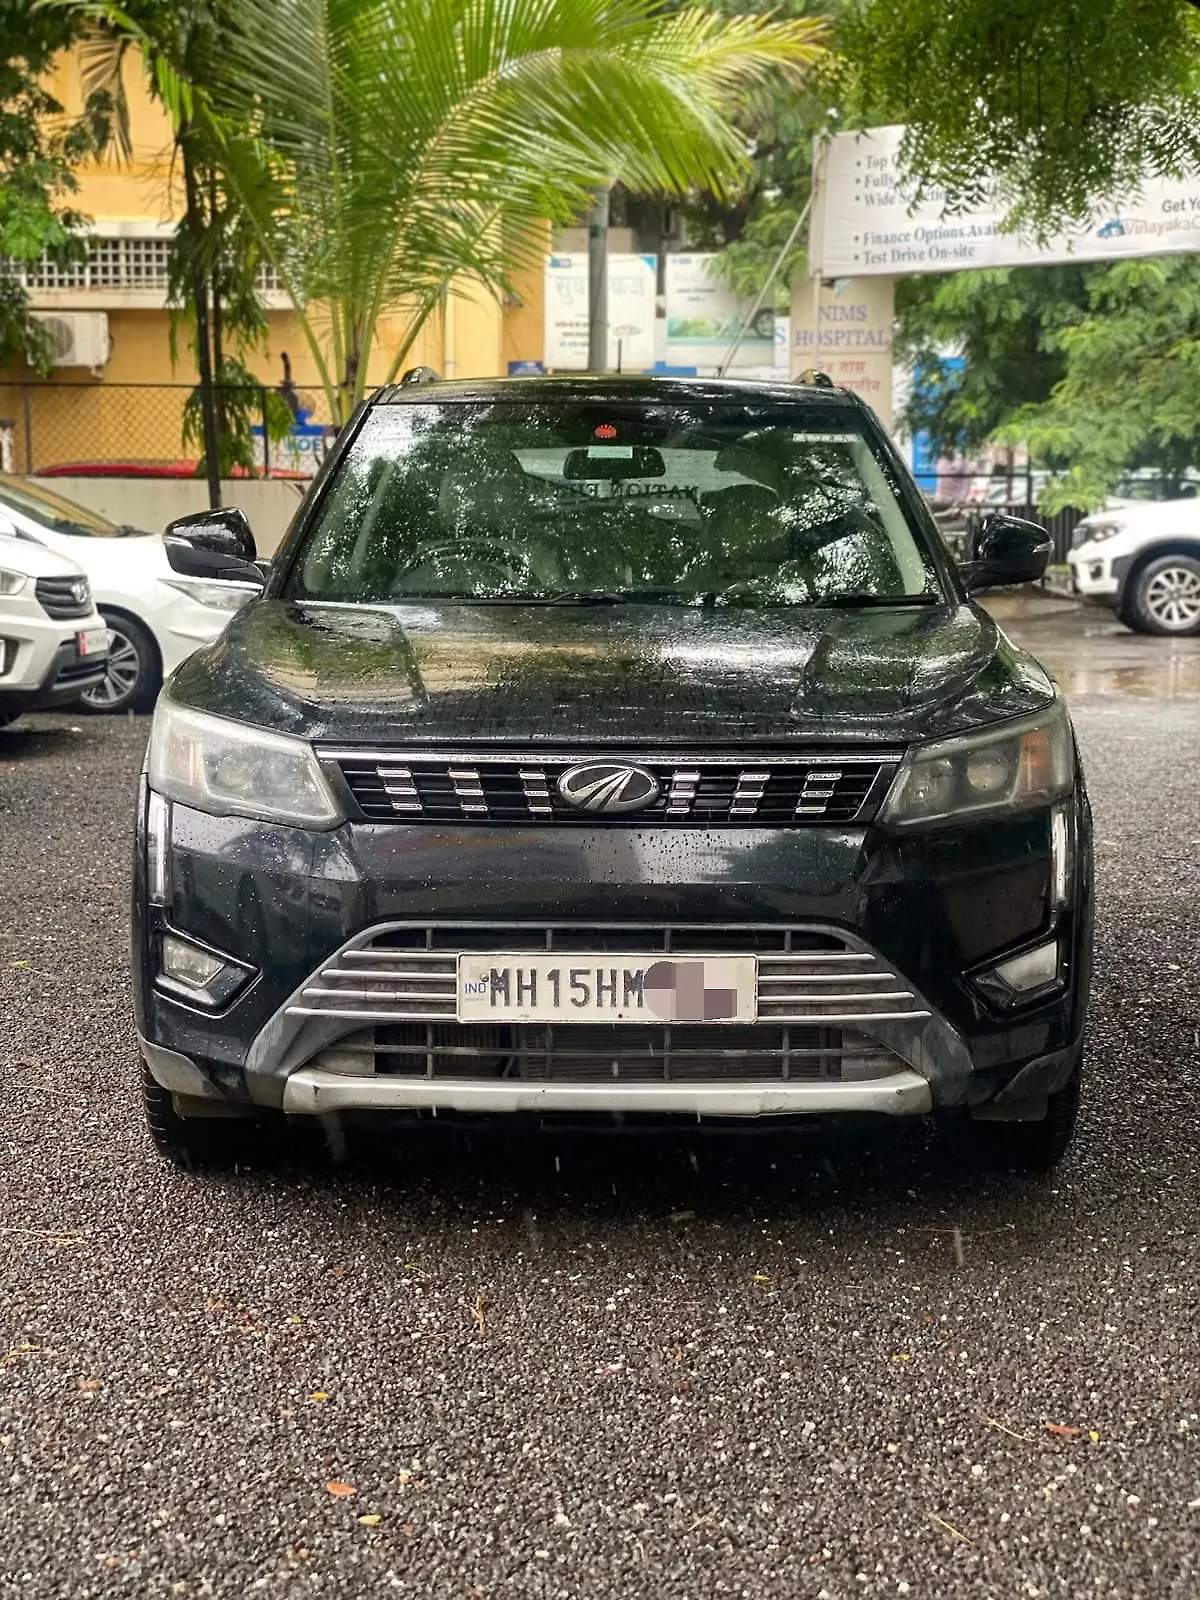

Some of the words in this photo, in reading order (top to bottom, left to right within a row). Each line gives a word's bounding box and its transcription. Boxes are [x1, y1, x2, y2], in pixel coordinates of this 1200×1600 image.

[866, 154, 888, 171] Top
[864, 174, 894, 190] Fully
[864, 191, 896, 207] Wide
[1161, 197, 1186, 213] Get
[863, 230, 910, 245] Finance
[914, 226, 965, 243] Options
[864, 250, 887, 265] Test
[891, 247, 925, 263] Drive
[928, 244, 975, 260] On-site
[817, 305, 866, 321] NIMS
[795, 329, 888, 346] HOSPITAL
[465, 982, 486, 994] IND
[490, 968, 644, 1008] MH15HM
